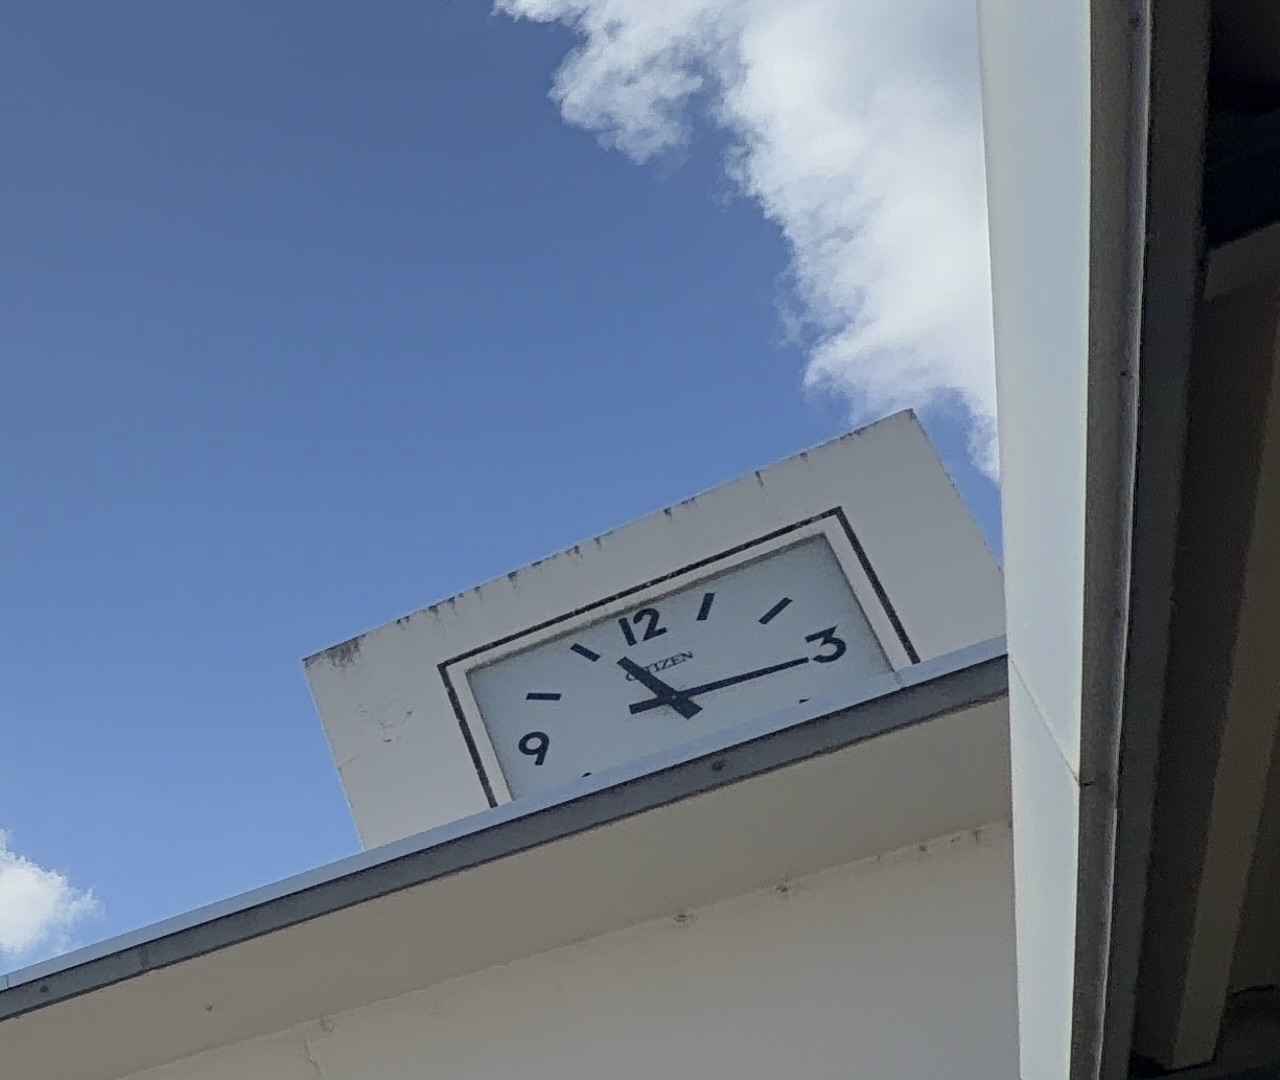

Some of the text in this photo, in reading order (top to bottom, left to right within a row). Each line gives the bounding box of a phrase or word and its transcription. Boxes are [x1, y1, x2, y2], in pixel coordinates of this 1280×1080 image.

[618, 607, 668, 646] 12
[805, 625, 847, 663] 3
[518, 731, 550, 766] 9
